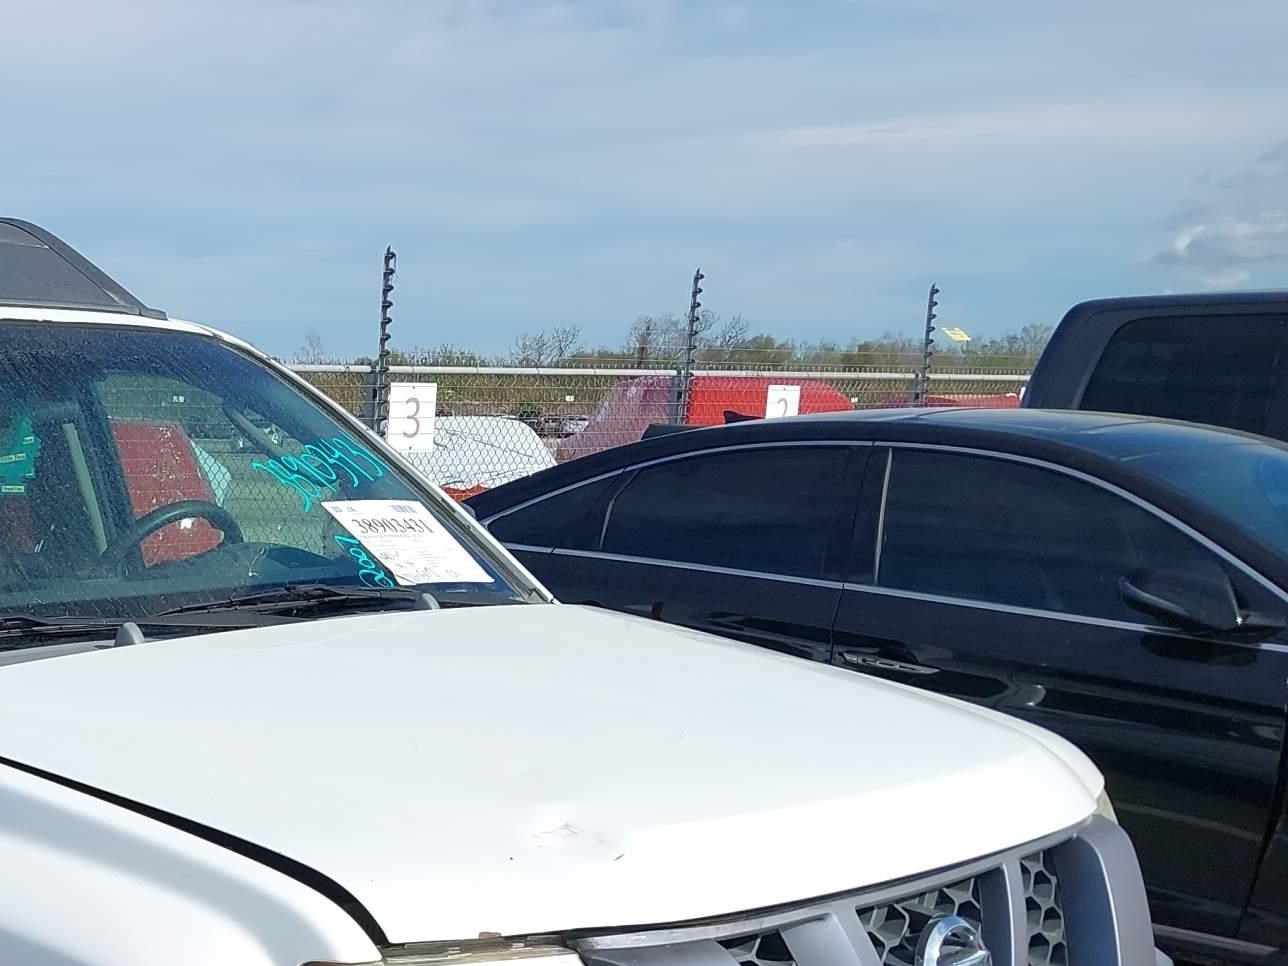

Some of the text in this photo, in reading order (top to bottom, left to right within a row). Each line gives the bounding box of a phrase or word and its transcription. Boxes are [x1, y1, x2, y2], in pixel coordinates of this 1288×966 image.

[402, 397, 420, 438] 3
[251, 430, 392, 512] 38903431
[351, 518, 434, 534] 38903431
